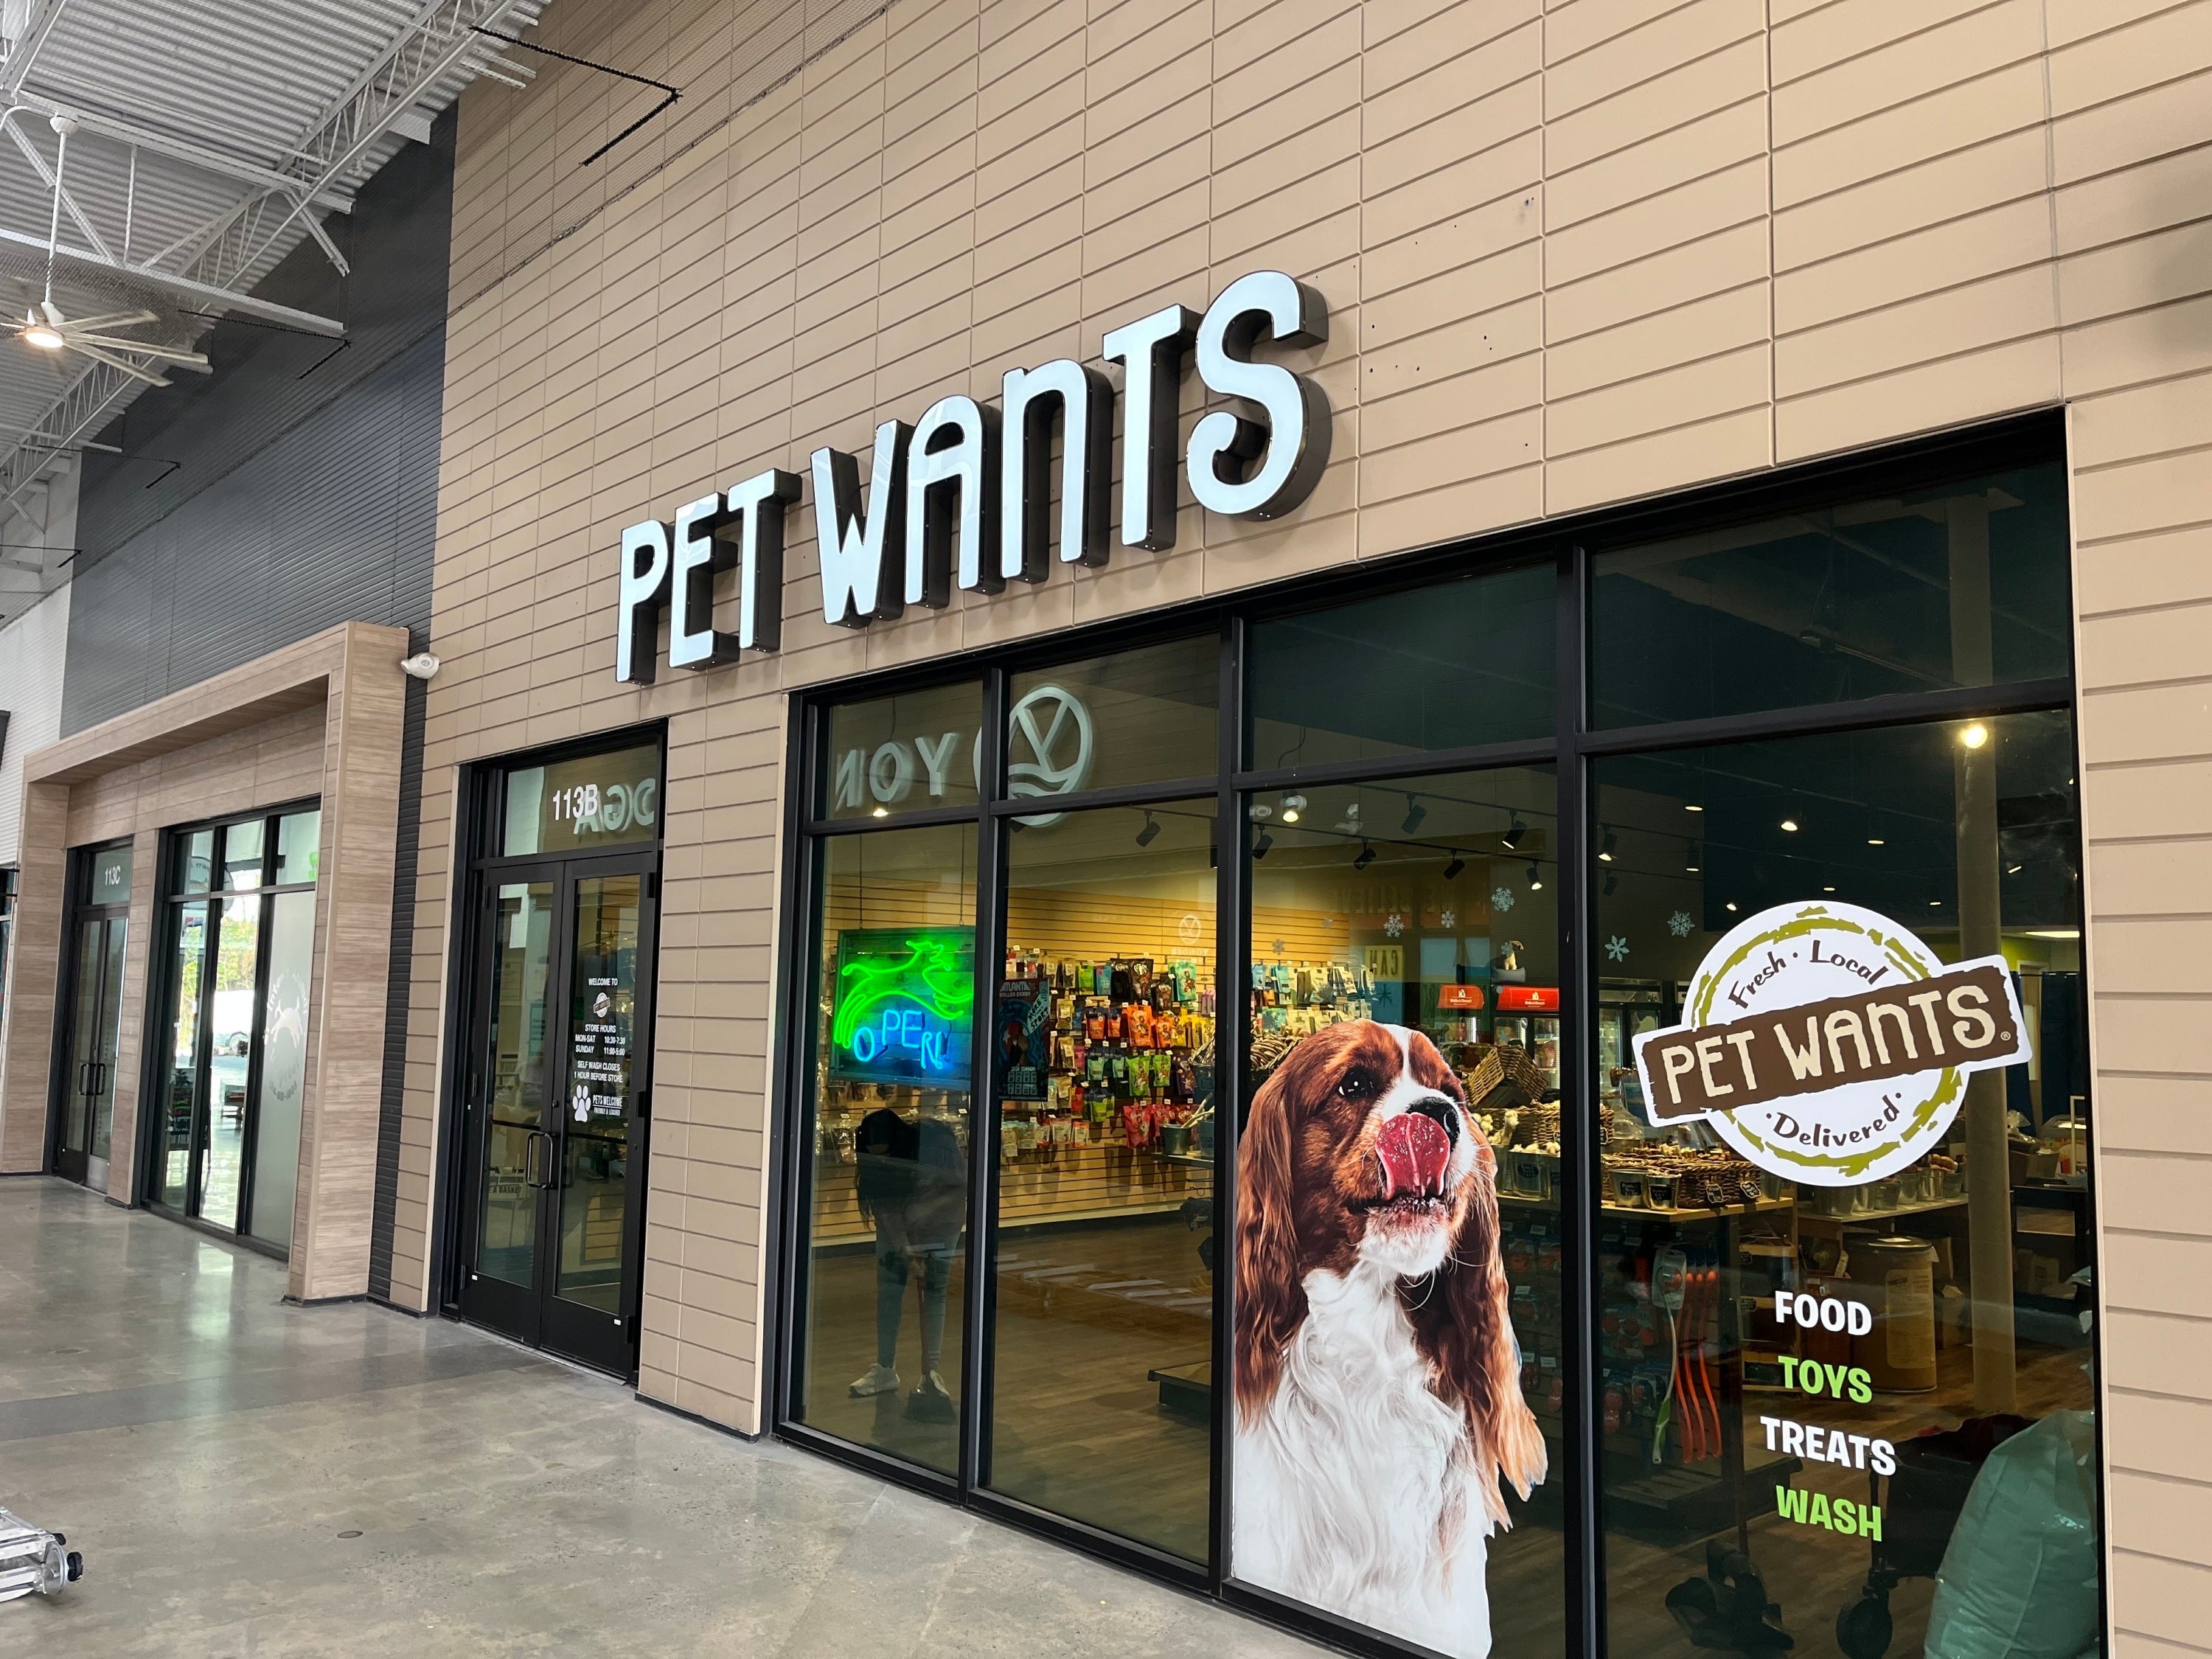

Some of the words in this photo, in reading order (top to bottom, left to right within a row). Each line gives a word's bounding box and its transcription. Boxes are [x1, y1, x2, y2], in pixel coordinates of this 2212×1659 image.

[616, 467, 795, 683] PET
[810, 268, 1324, 627] WANTS
[553, 784, 598, 821] 113B
[105, 865, 121, 886] 113C
[588, 978, 611, 986] WELCOME
[612, 978, 618, 986] TO
[1728, 951, 1786, 1009] Fresh
[1809, 940, 1889, 986] Local
[575, 1034, 596, 1043] MON-SAT
[576, 1045, 594, 1053] SUNDAY
[585, 1024, 599, 1032] STORE
[600, 1025, 616, 1033] HOURS
[854, 1009, 943, 1069] OPEN
[1662, 1030, 1757, 1105] PET
[1774, 985, 1996, 1081] WANTS
[577, 1060, 588, 1068] SELF
[588, 1062, 602, 1070] WASH
[602, 1062, 620, 1071] CLOSES
[577, 1071, 590, 1079] HOUR
[591, 1072, 607, 1081] BEFORE
[608, 1074, 623, 1082] STORE
[593, 1094, 602, 1105] PETS
[1773, 1101, 1901, 1147] Delivered
[1775, 1290, 1872, 1336] FOOD
[1778, 1356, 1872, 1403] TOYS
[1760, 1416, 1896, 1476] TREATS
[1775, 1485, 1882, 1542] WASH
